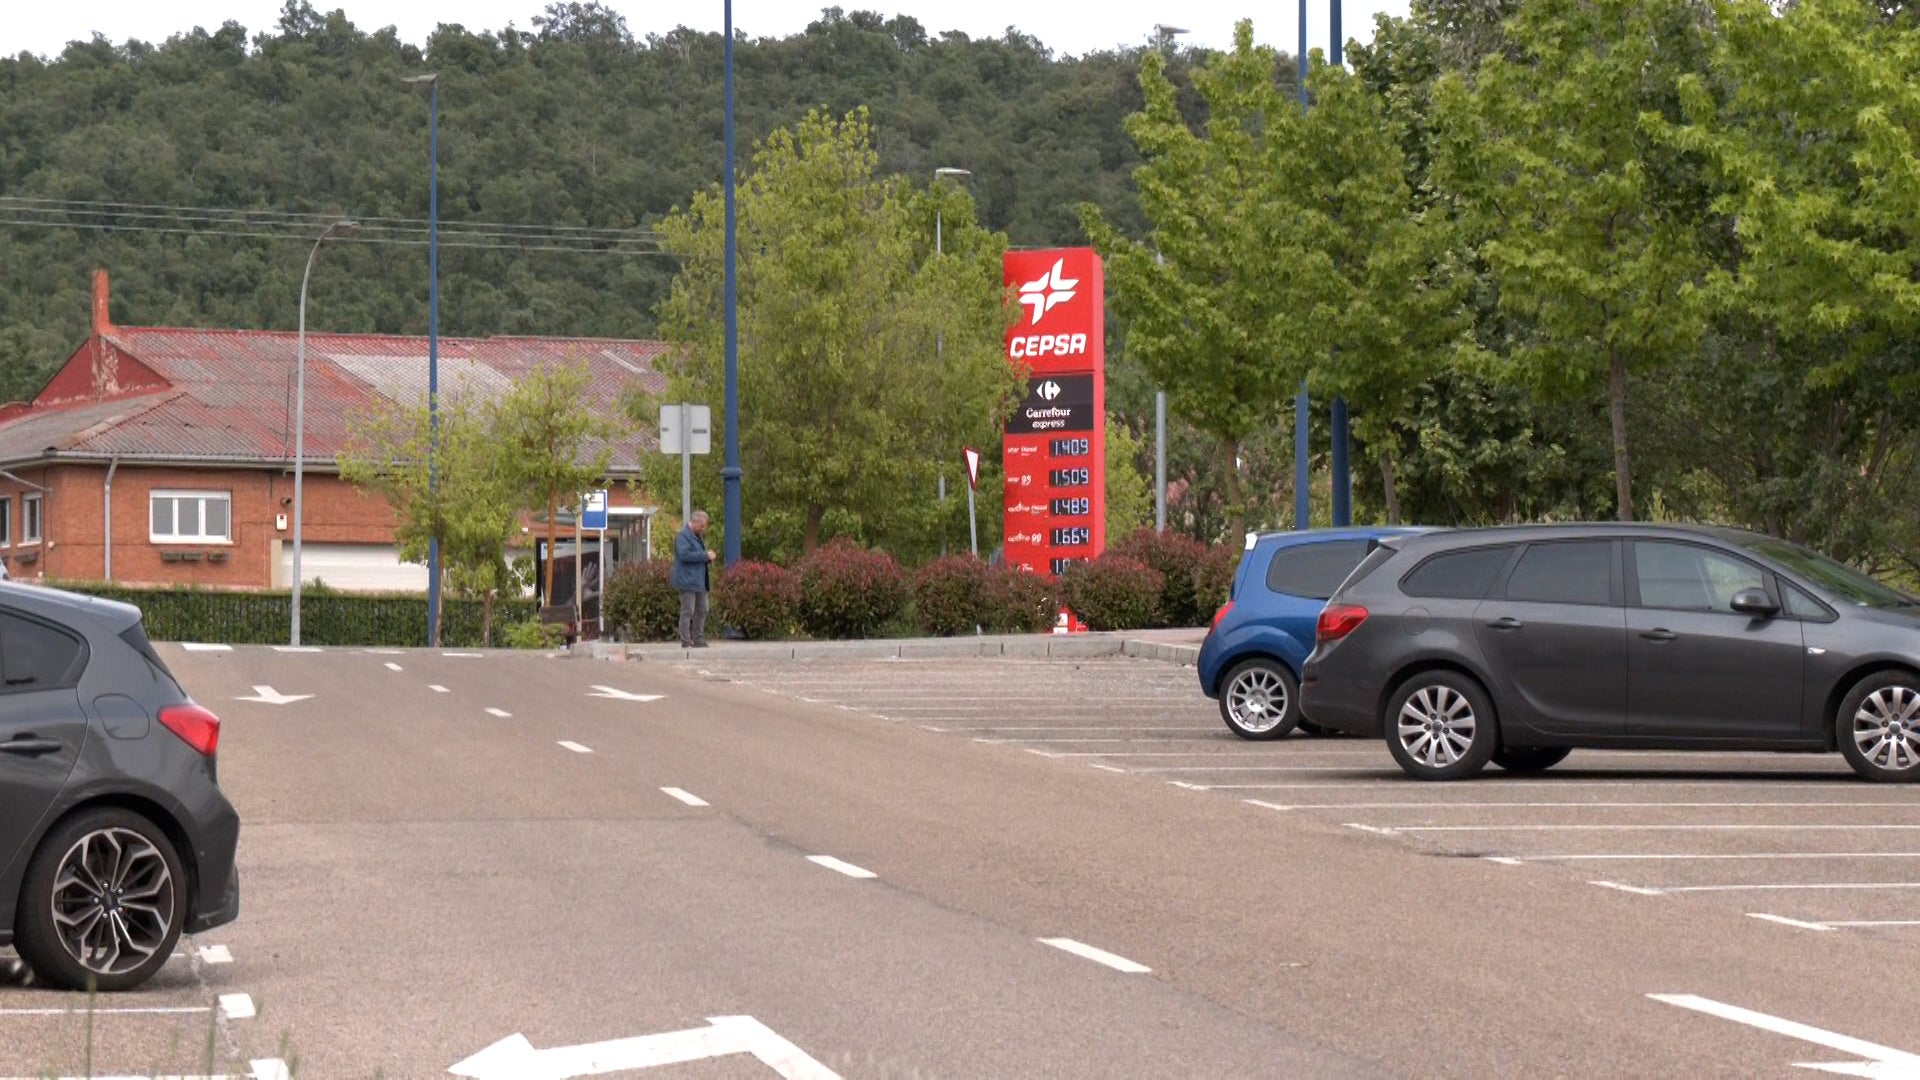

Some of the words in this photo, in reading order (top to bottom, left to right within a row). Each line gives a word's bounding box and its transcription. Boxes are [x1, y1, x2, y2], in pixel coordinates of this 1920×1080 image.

[1009, 333, 1087, 357] CEPSA
[1026, 407, 1071, 418] Carrefour
[1032, 420, 1065, 429] express
